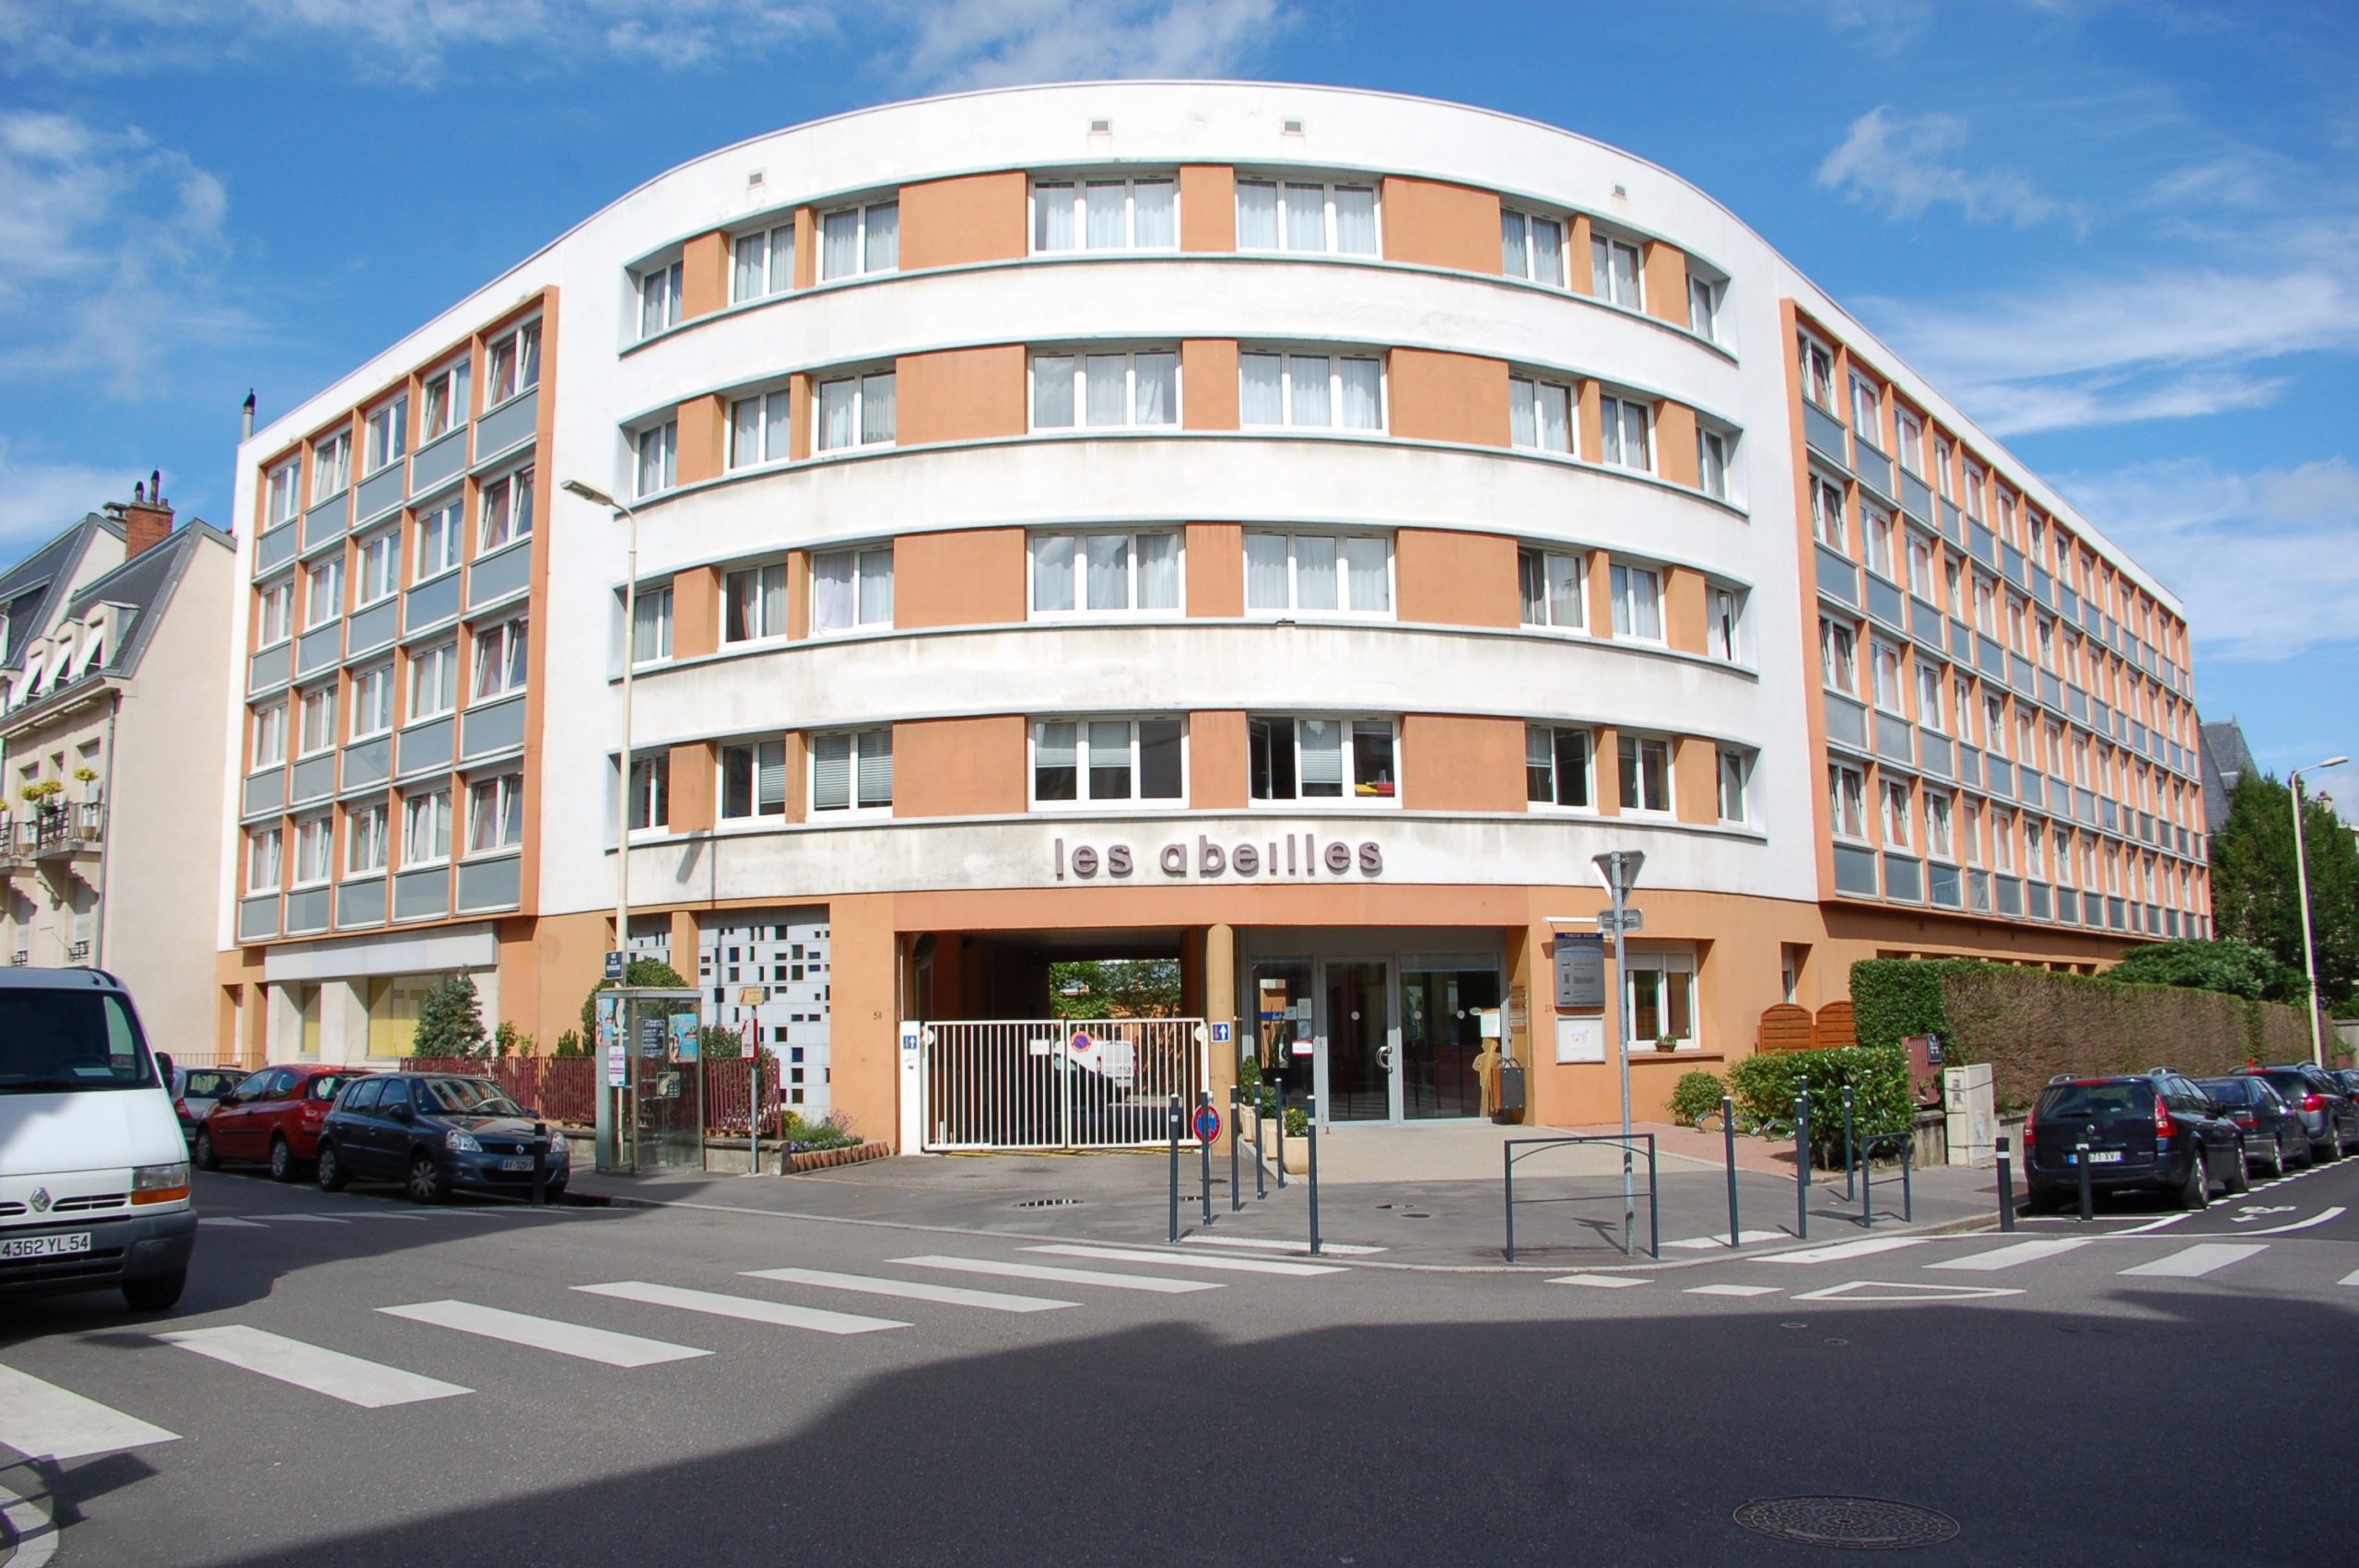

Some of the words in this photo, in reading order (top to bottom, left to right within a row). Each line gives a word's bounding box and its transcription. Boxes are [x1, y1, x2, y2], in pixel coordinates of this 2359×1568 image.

[1055, 838, 1133, 880] les
[1160, 834, 1383, 877] abeilles
[3, 1239, 44, 1257] 4362
[48, 1237, 66, 1252] YL
[69, 1235, 88, 1250] 54
